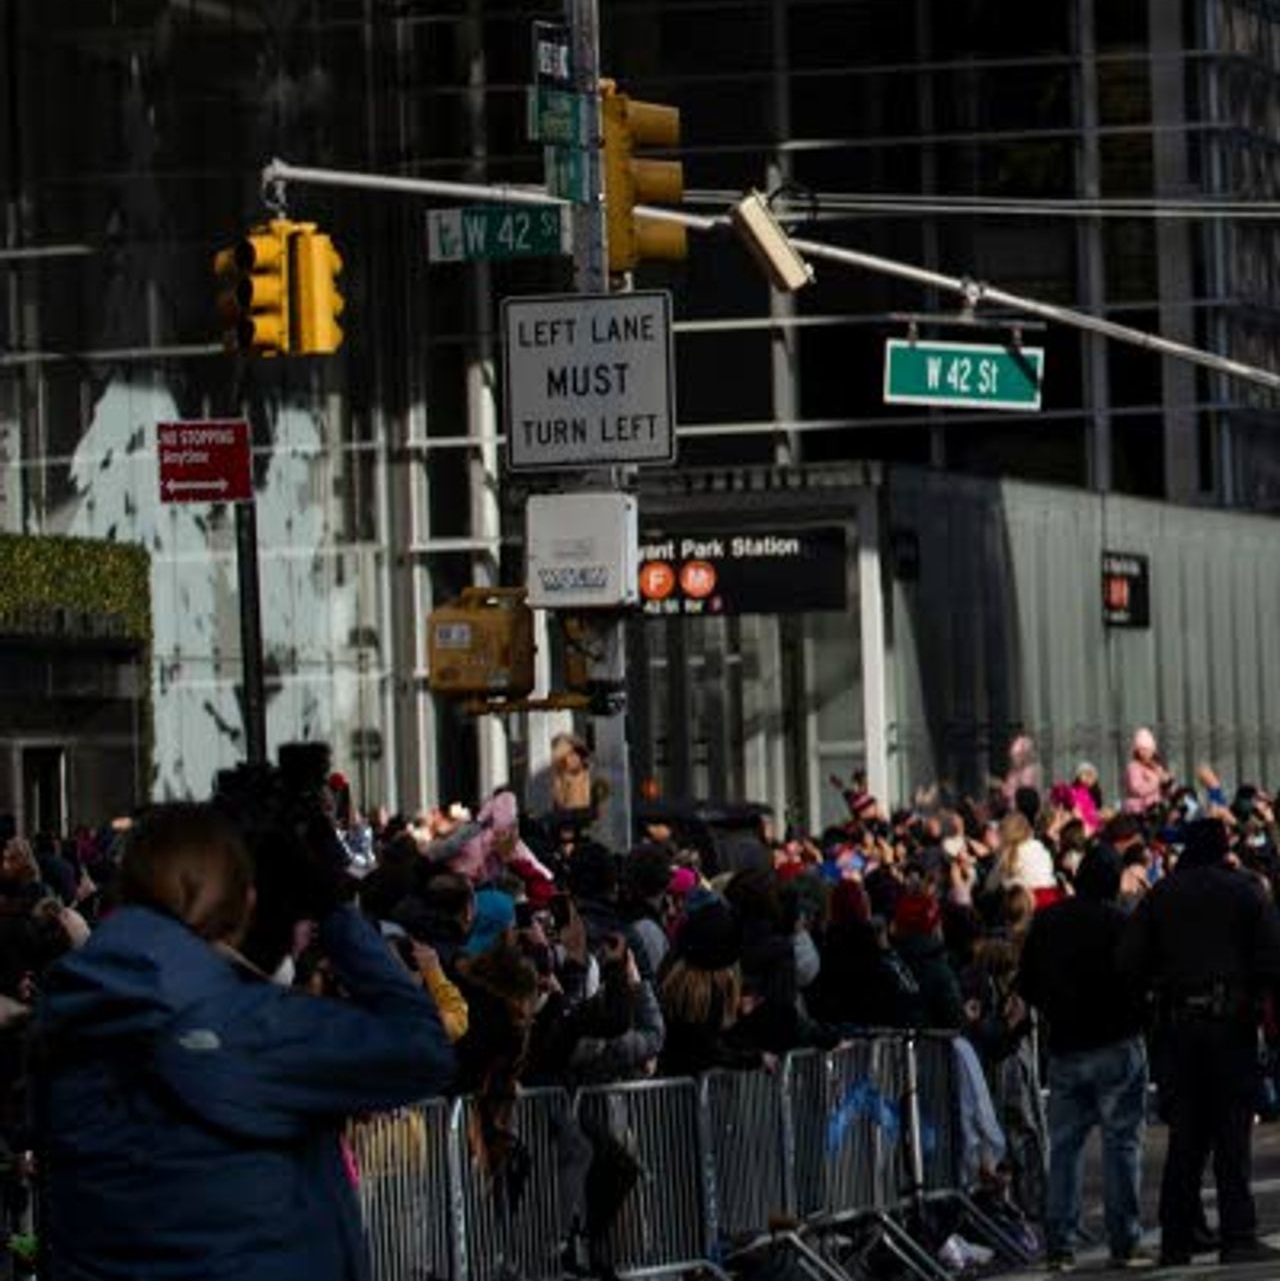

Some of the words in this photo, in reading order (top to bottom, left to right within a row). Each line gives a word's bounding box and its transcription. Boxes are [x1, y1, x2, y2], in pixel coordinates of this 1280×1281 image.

[463, 215, 488, 253] W
[497, 213, 532, 251] 42
[519, 320, 576, 347] LEFT
[592, 315, 654, 343] LANE
[547, 363, 629, 398] MUST
[927, 356, 942, 390] W
[947, 357, 971, 392] 42
[978, 359, 998, 394] St
[523, 418, 586, 447] TURN
[602, 414, 657, 442] LEFT
[681, 538, 724, 559] Park
[732, 536, 799, 558] Station
[649, 569, 665, 592] F
